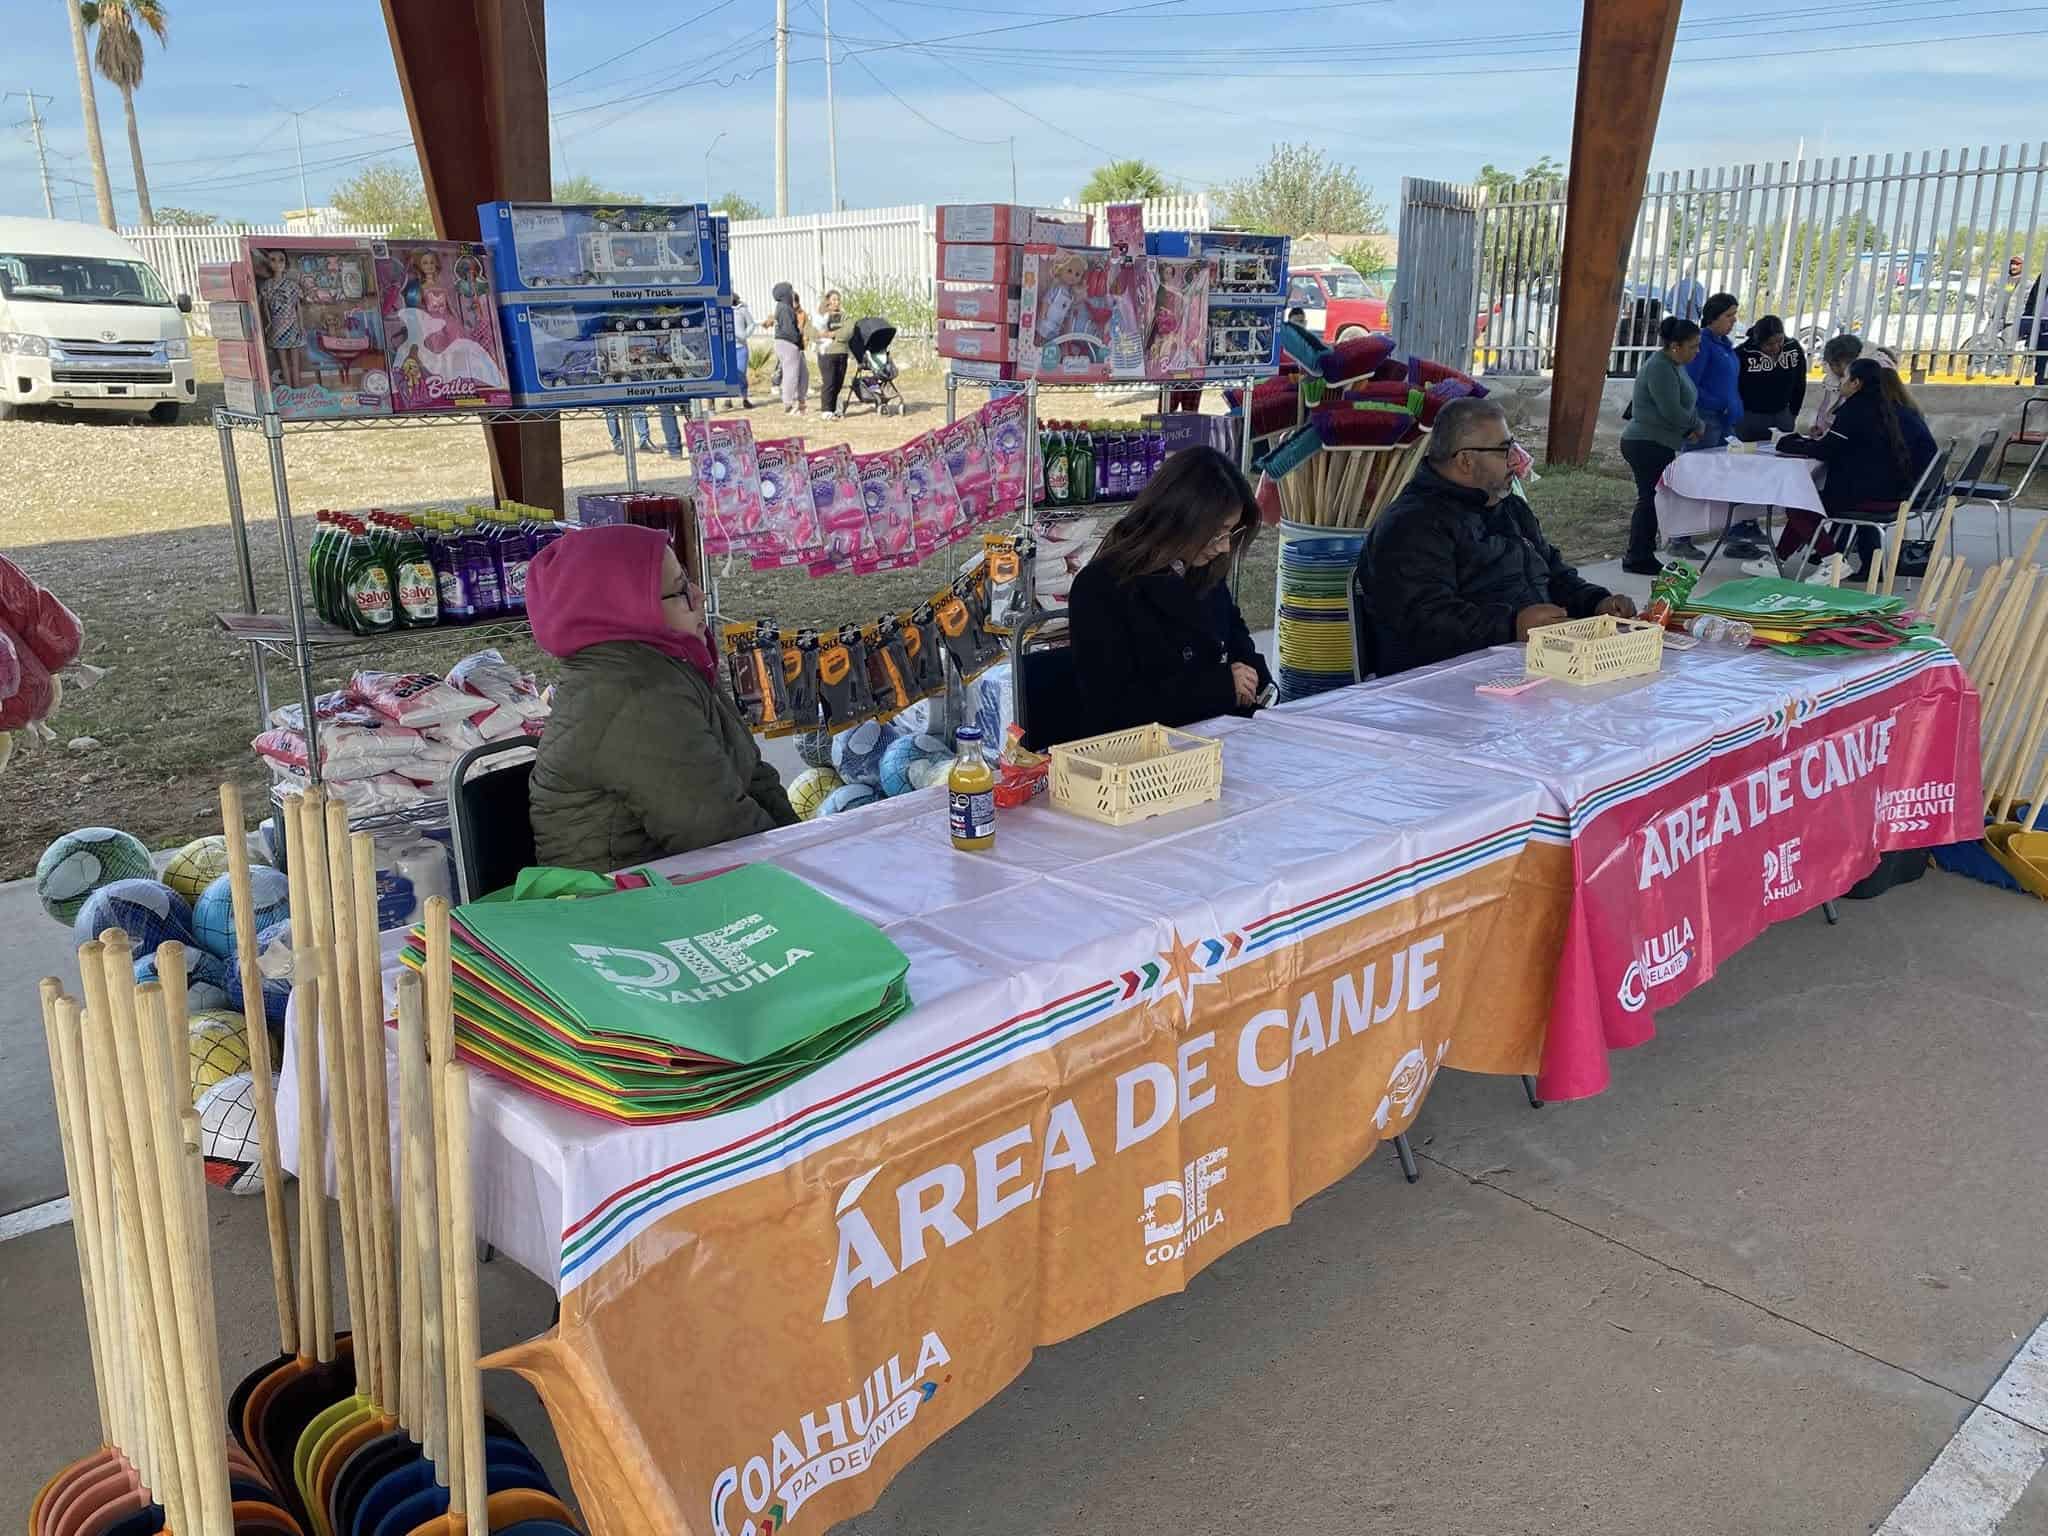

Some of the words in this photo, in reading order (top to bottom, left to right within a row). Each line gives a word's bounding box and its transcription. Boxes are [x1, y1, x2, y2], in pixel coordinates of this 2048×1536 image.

[612, 290, 641, 299] Heavy
[644, 288, 673, 297] Truck
[426, 375, 477, 399] Bailee
[626, 387, 656, 396] Heavy
[657, 384, 687, 394] Truck
[356, 591, 391, 604] Salvo
[400, 586, 435, 600] Salvo
[1747, 757, 1794, 829] DE
[1800, 716, 1897, 799] CANJE
[567, 912, 780, 989] DIF
[614, 947, 816, 1004] COAHUILA
[822, 1164, 1097, 1324] ÁREA
[1114, 1030, 1217, 1154] DE
[1236, 933, 1446, 1088] CANJE
[1141, 1146, 1230, 1247] DIF
[1144, 1207, 1226, 1267] COAHUILA
[710, 1331, 952, 1536] COAHUILA
